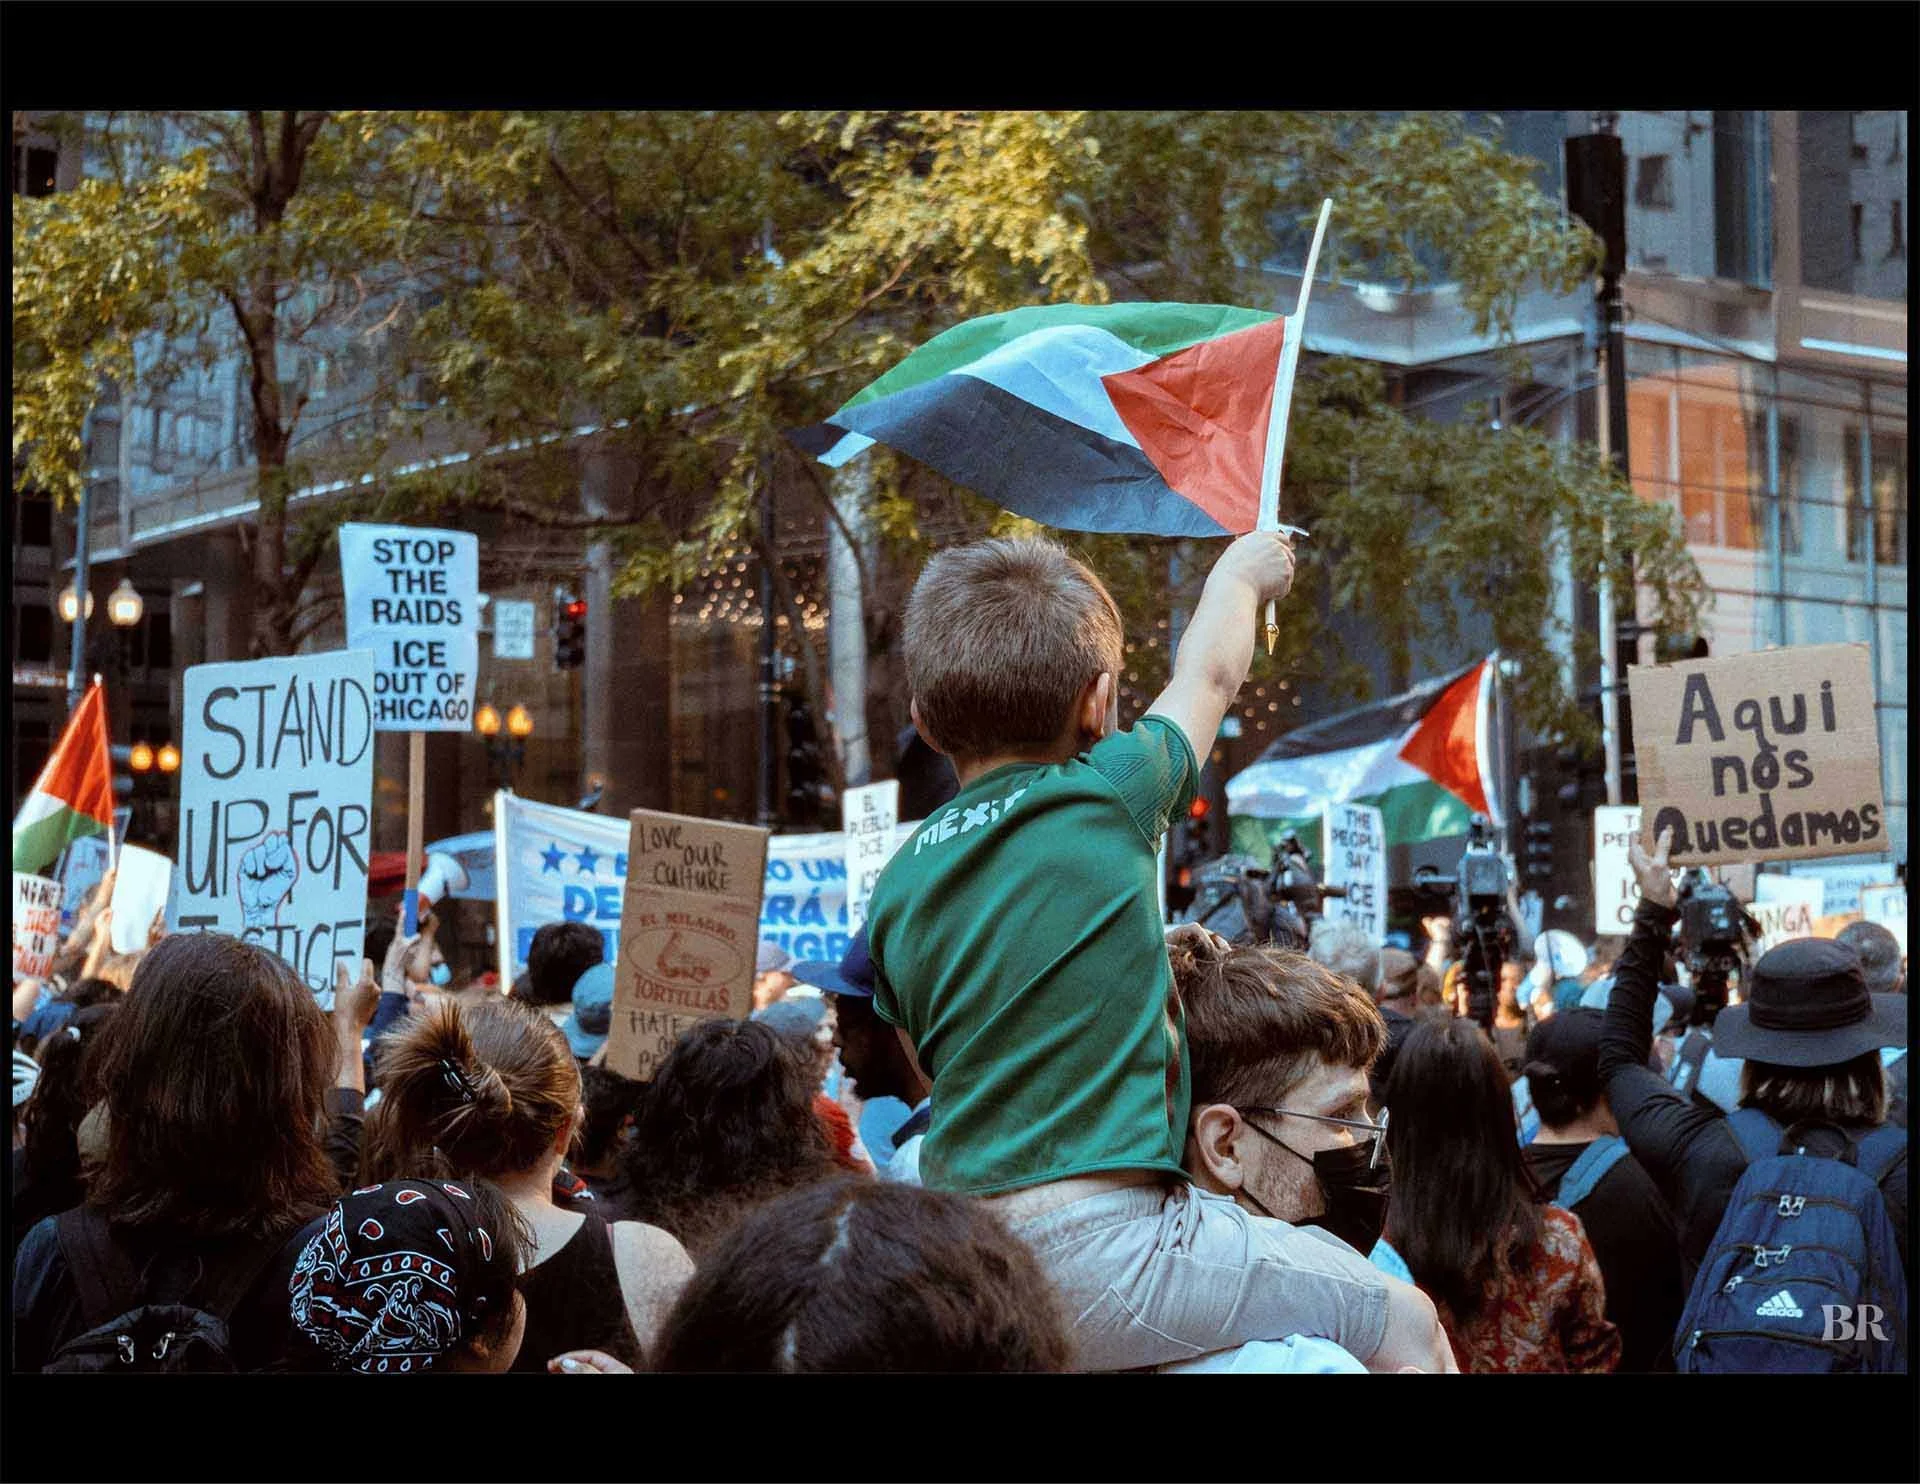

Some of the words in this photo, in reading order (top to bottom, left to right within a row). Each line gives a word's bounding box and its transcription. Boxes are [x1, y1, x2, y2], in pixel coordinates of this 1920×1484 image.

[373, 538, 455, 565] STOP
[386, 568, 447, 595] THE
[372, 599, 462, 626] RAIDS
[393, 641, 446, 668] ICE
[374, 672, 427, 694] OUT
[436, 674, 464, 695] OF
[1676, 672, 1836, 751] Aqui
[203, 674, 370, 780] STAND
[1711, 749, 1814, 797] nos
[1346, 810, 1370, 830] THE
[186, 798, 269, 898] UP
[287, 790, 369, 905] FOR
[684, 842, 728, 867] OUR
[1346, 851, 1370, 869] SAY
[654, 861, 732, 892] CULTURE
[634, 973, 730, 1012] TORTILLAS
[1756, 1306, 1803, 1318] adidas
